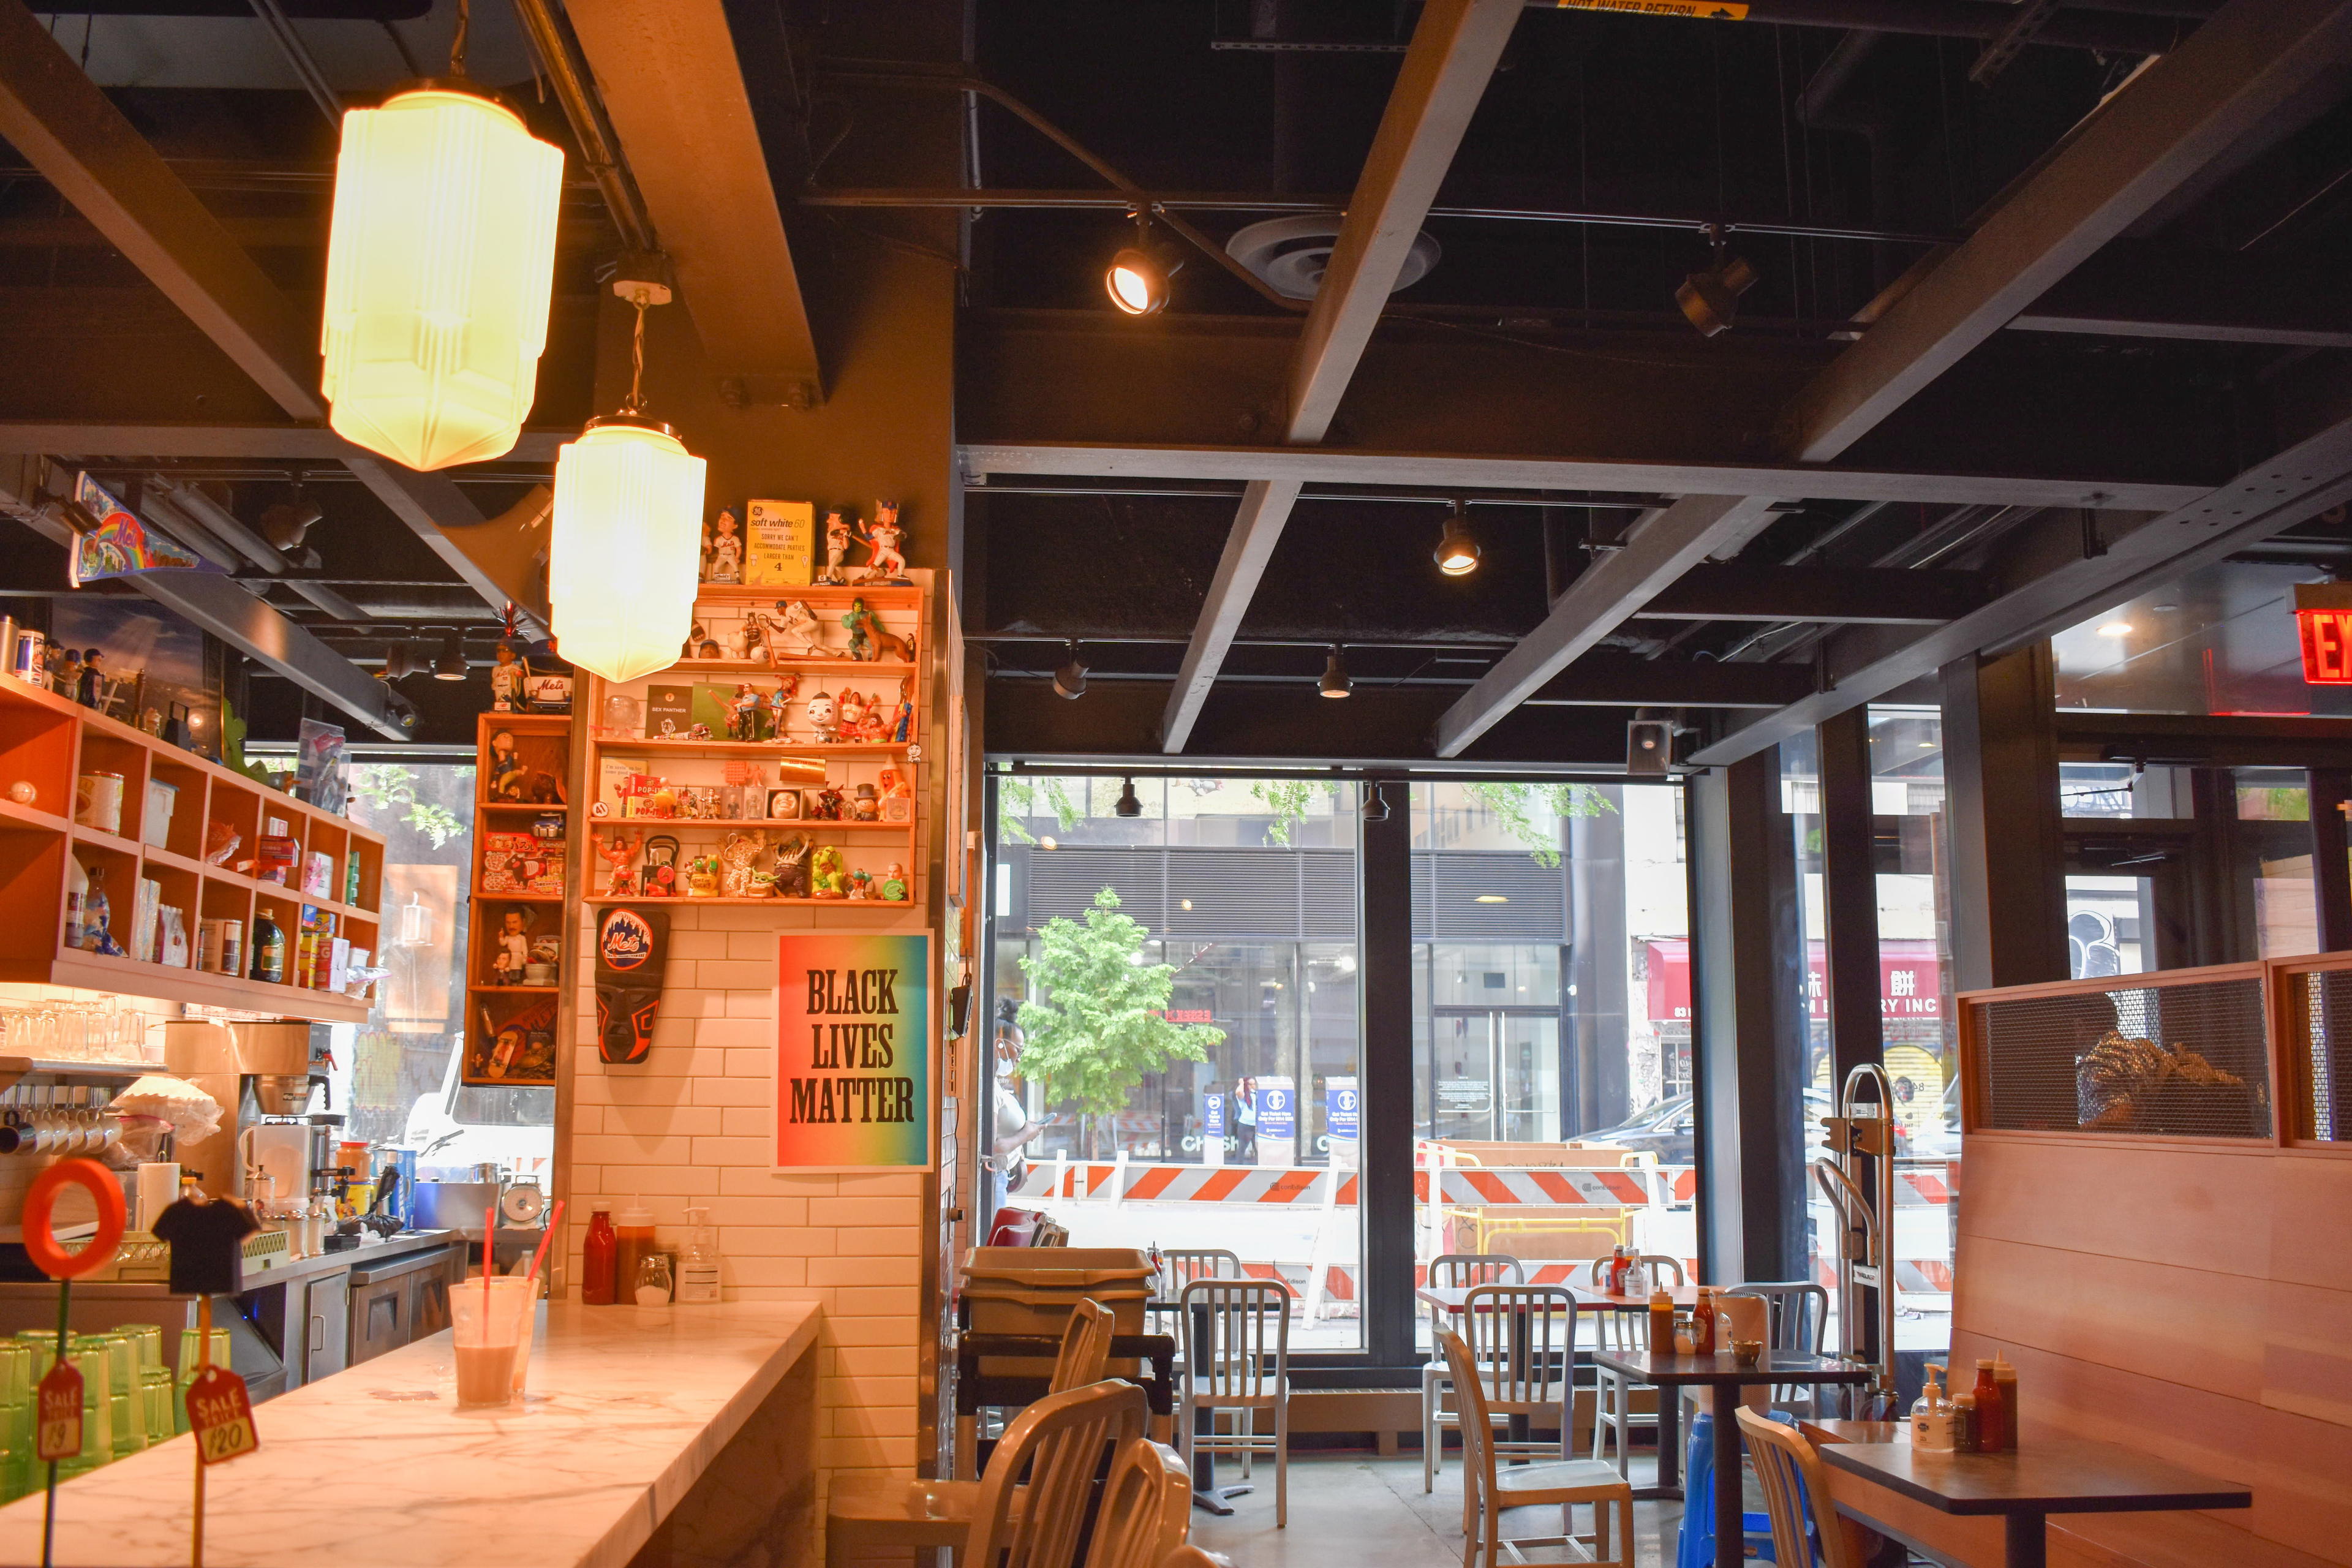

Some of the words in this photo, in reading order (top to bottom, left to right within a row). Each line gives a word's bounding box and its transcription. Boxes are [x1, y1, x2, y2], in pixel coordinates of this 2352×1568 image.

[750, 518, 767, 527] soft
[770, 519, 793, 528] white
[794, 519, 805, 528] 60
[774, 562, 783, 571] 4
[537, 679, 564, 690] Mets
[608, 932, 640, 952] Mets
[806, 969, 899, 1015] BLACK
[1905, 998, 1937, 1013] INC
[811, 1023, 894, 1069] LIVES
[789, 1077, 914, 1123] MATTER
[45, 1386, 78, 1406] SALE
[196, 1387, 242, 1413] SALE
